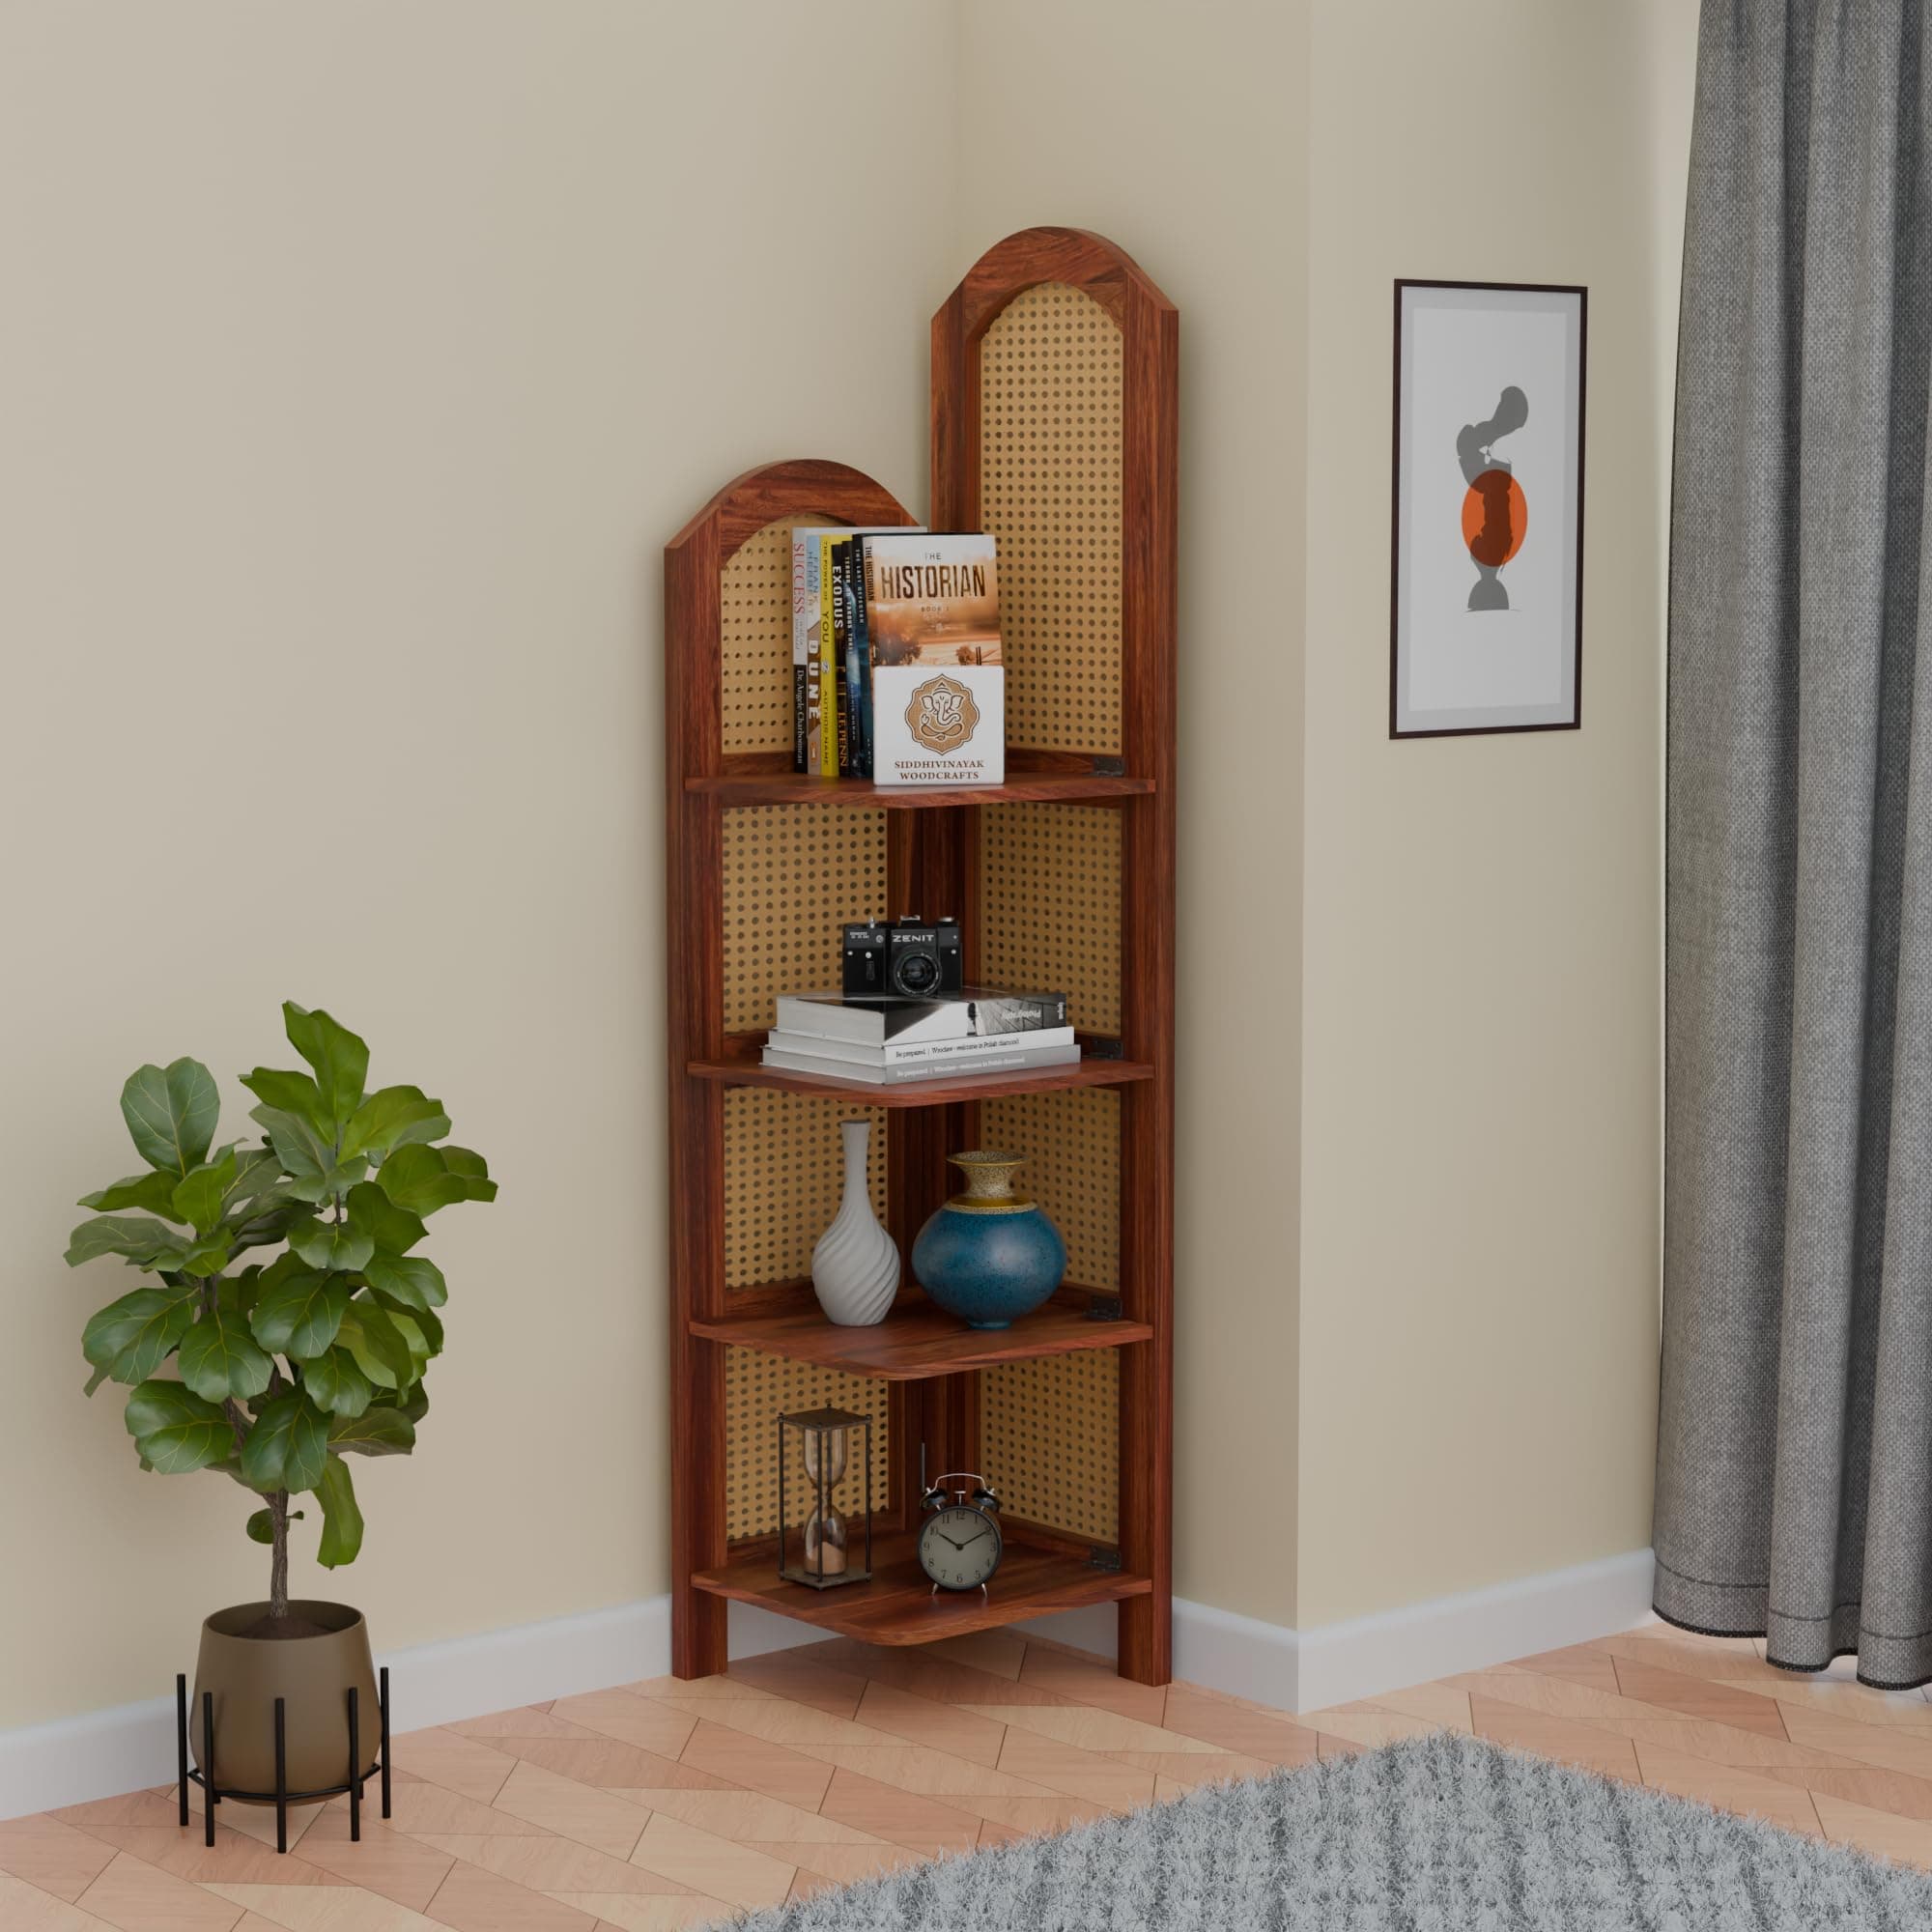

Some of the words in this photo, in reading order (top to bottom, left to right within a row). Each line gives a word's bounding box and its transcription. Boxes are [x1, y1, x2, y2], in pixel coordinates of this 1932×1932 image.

[924, 552, 943, 560] THE
[793, 543, 805, 614] SUCCESS
[881, 564, 986, 600] HISTORIAN
[833, 565, 844, 629] EXODUS
[808, 639, 820, 720] DUNE
[895, 760, 984, 769] SIDDHIVINAYAK
[892, 934, 935, 943] ZENIT
[942, 1514, 951, 1524] 11
[956, 1510, 965, 1520] 12
[927, 1557, 935, 1568] 8
[941, 1569, 947, 1578] 7
[956, 1574, 963, 1583] 6
[975, 1570, 981, 1579] 5
